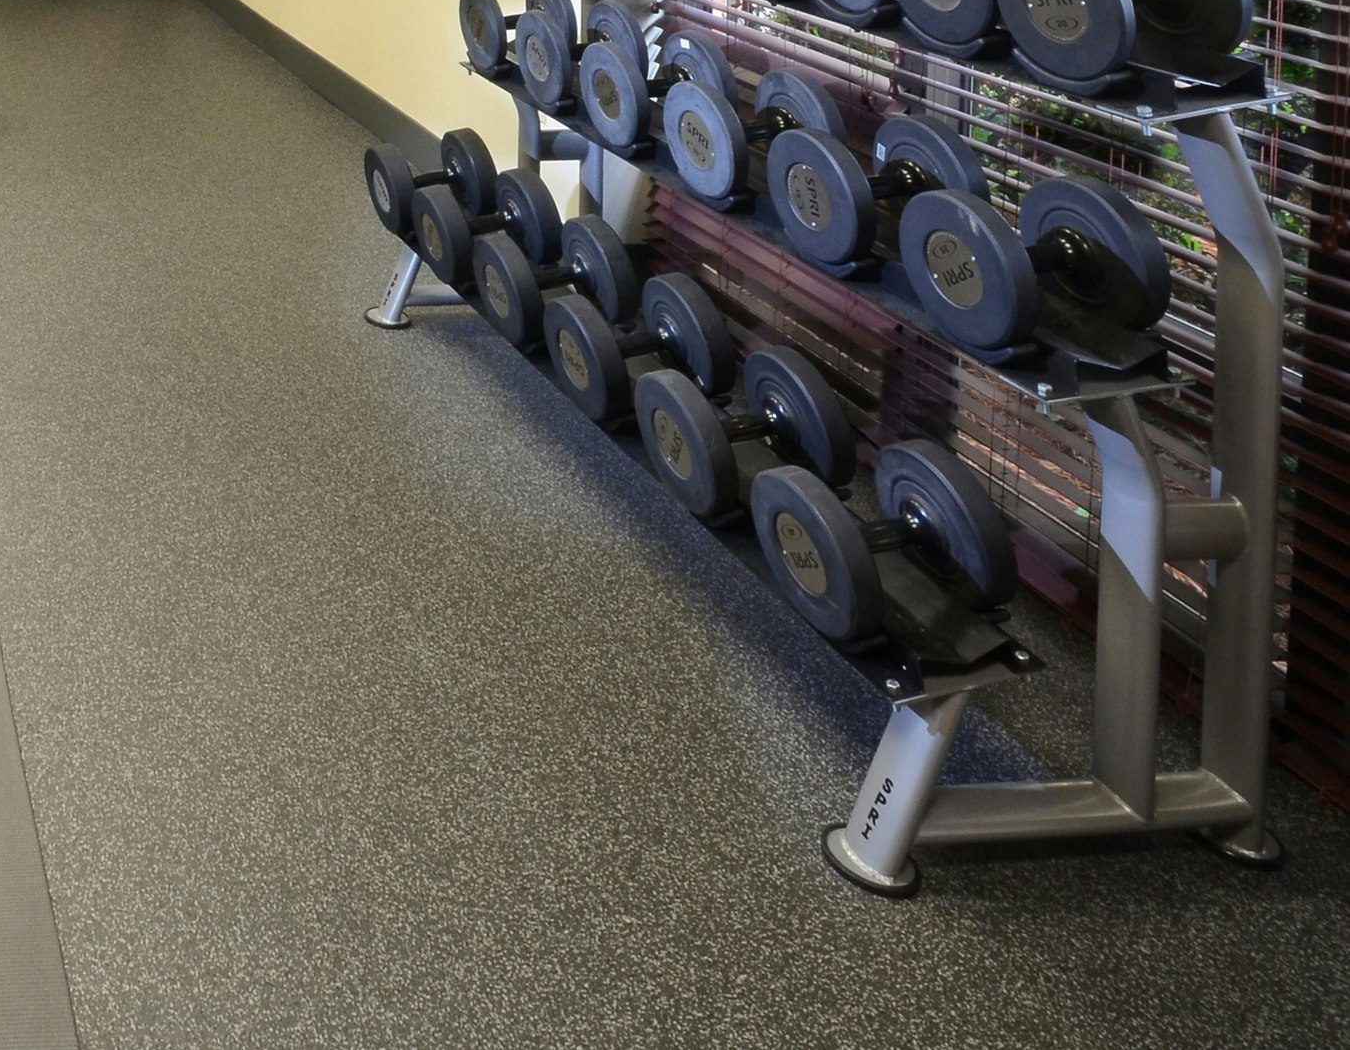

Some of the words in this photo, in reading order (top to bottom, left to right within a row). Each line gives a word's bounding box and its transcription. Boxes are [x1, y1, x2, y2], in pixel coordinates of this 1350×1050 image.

[1054, 18, 1066, 28] 20
[686, 122, 709, 150] SPRI
[803, 176, 818, 218] SPRI
[942, 261, 975, 288] SPRI
[670, 431, 682, 463] SPRI
[790, 552, 818, 569] SPRI
[862, 778, 894, 840] SPRI
